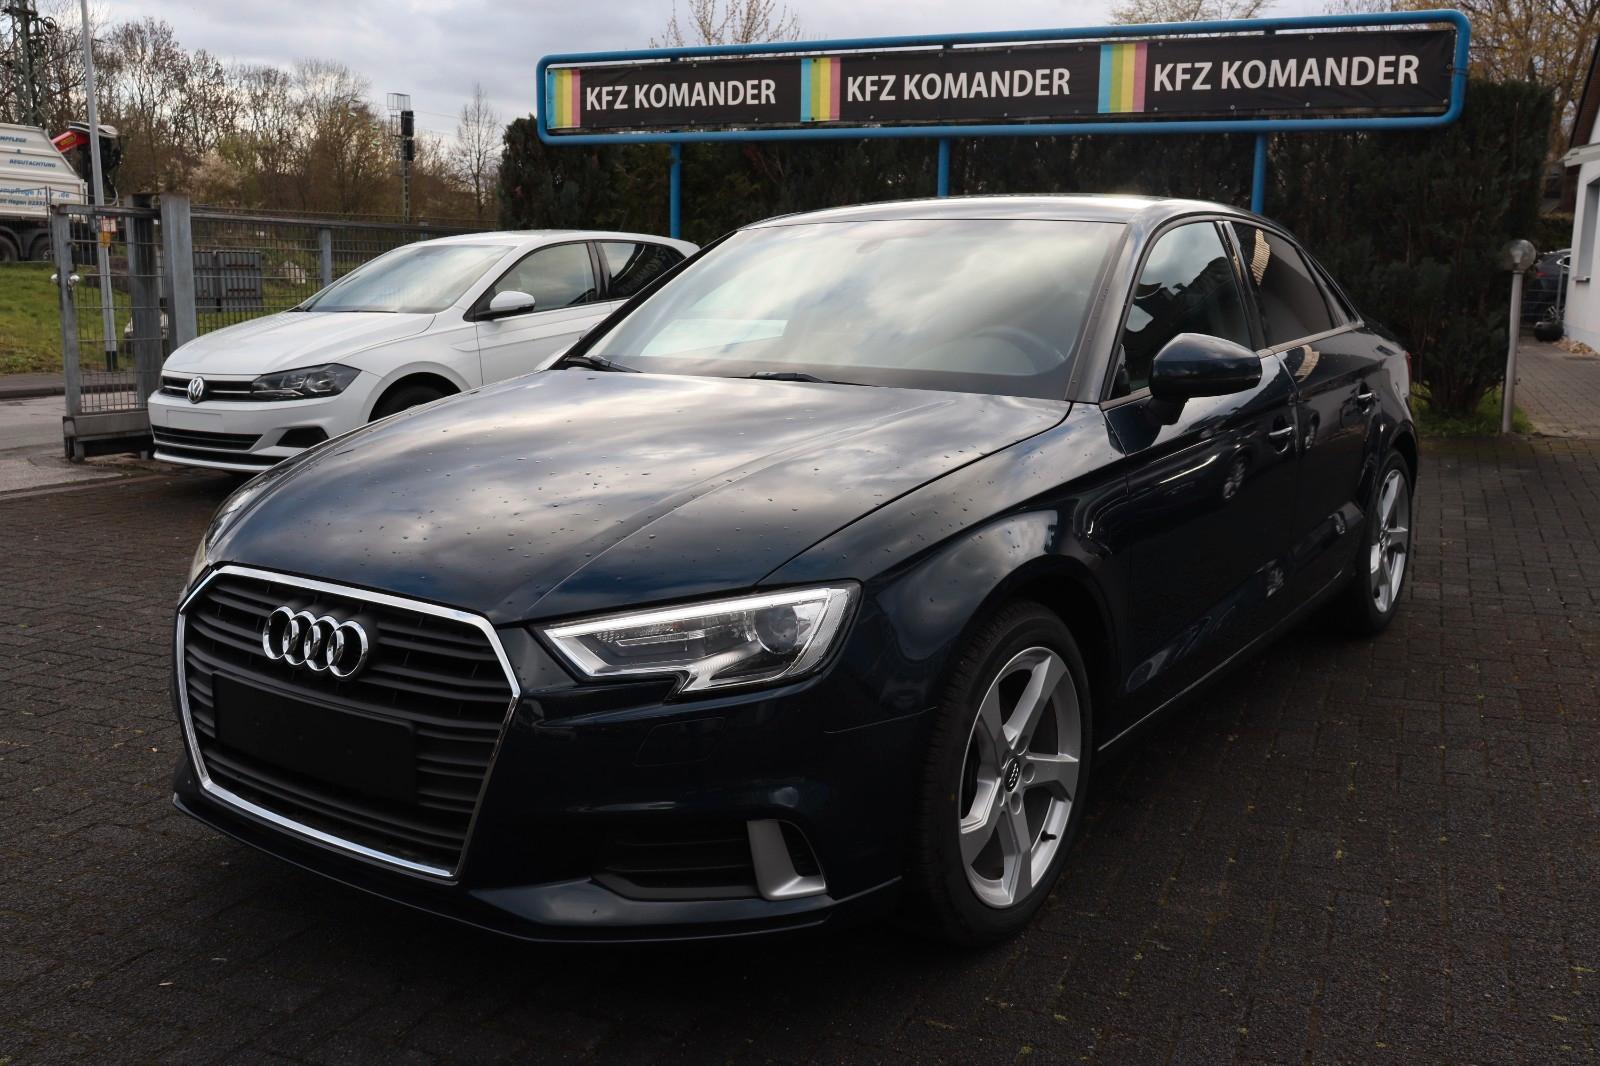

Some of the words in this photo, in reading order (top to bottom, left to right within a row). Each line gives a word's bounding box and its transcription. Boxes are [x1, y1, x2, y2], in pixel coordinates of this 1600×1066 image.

[847, 74, 897, 102] KFZ
[903, 67, 1071, 101] KOMANDER
[1153, 61, 1213, 92] KFZ
[1221, 54, 1420, 90] KOMANDER
[586, 85, 629, 111] KFZ
[634, 78, 777, 110] KOMANDER
